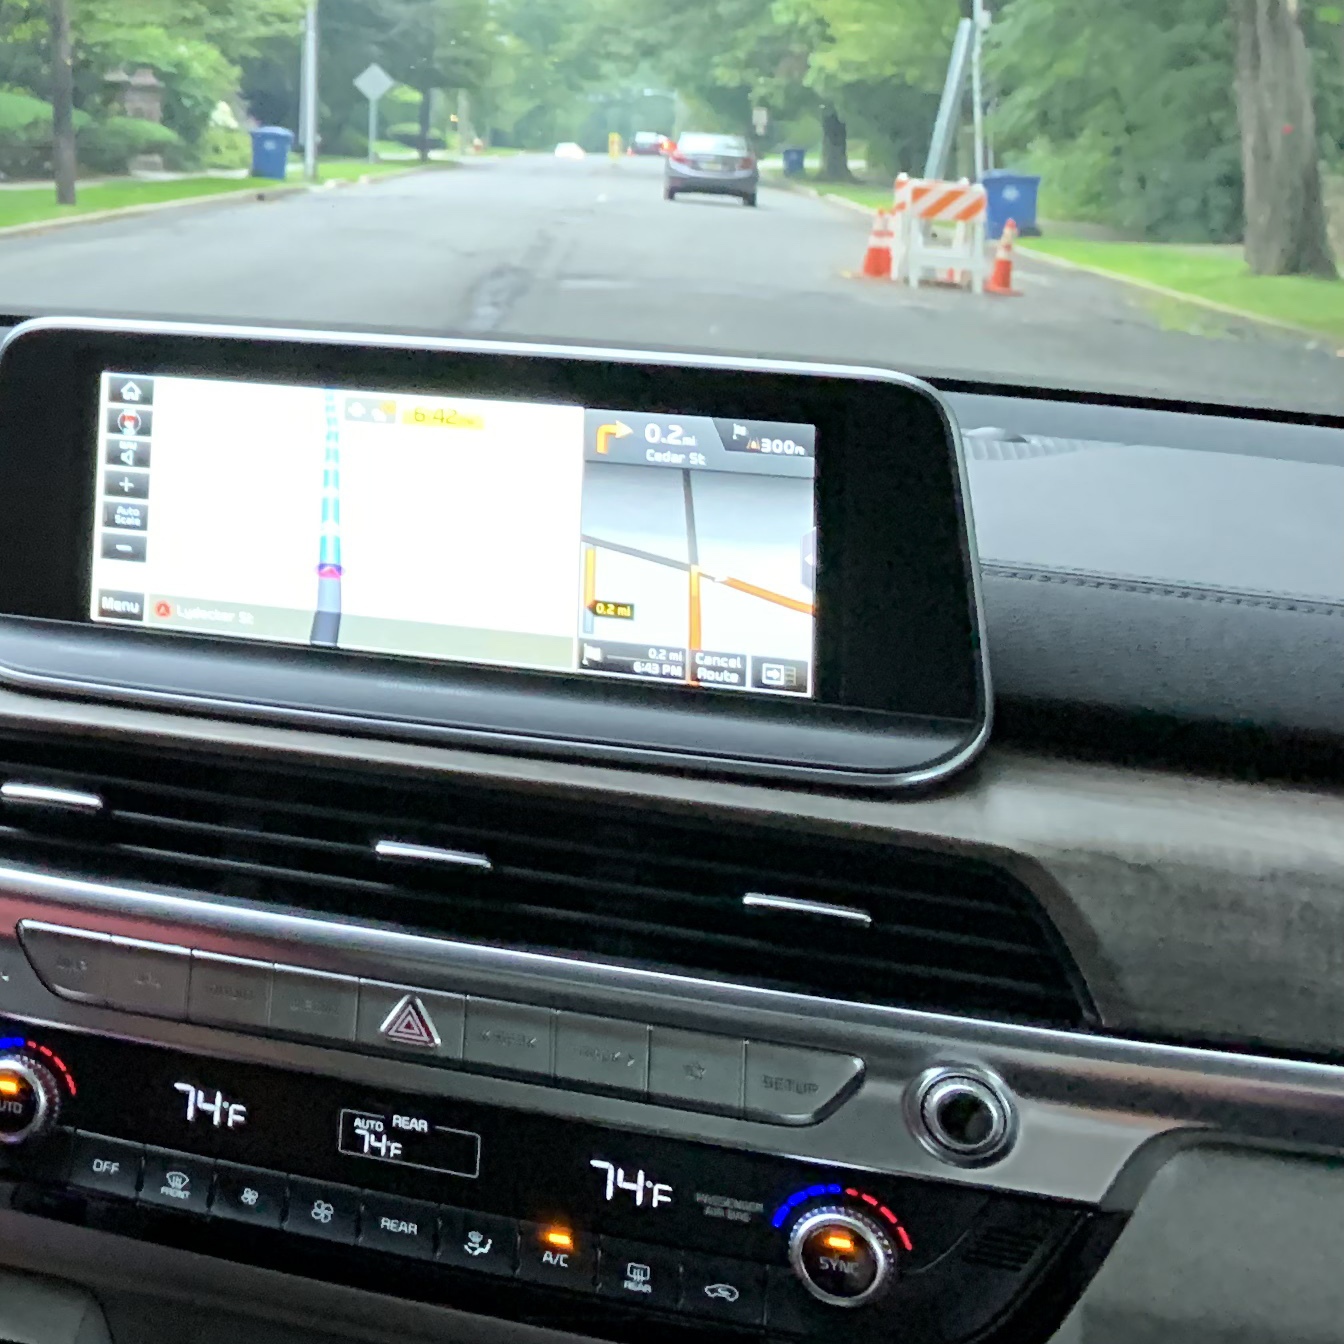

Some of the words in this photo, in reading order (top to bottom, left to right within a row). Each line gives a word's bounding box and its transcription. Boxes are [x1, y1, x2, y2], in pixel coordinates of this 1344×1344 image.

[646, 449, 686, 464] Cedar
[689, 451, 707, 466] St
[116, 505, 141, 517] Auto
[114, 514, 142, 527] Scale
[101, 596, 140, 615] Menu
[595, 602, 615, 615] 0.2
[617, 604, 631, 617] mi
[648, 647, 667, 661] 0.2
[669, 649, 683, 662] mi
[695, 652, 742, 669] Cancel
[632, 661, 659, 675] 6:43
[662, 663, 683, 678] PM
[696, 667, 740, 683] Route
[761, 1074, 820, 1095] SETUP
[353, 1117, 385, 1132] AUTO
[392, 1114, 429, 1134] REAR
[92, 1158, 120, 1174] OFF
[160, 1185, 192, 1200] FRONT
[379, 1216, 419, 1235] REAR
[542, 1250, 569, 1268] A/C
[819, 1257, 860, 1276] SYNC
[623, 1279, 652, 1294] REAR
